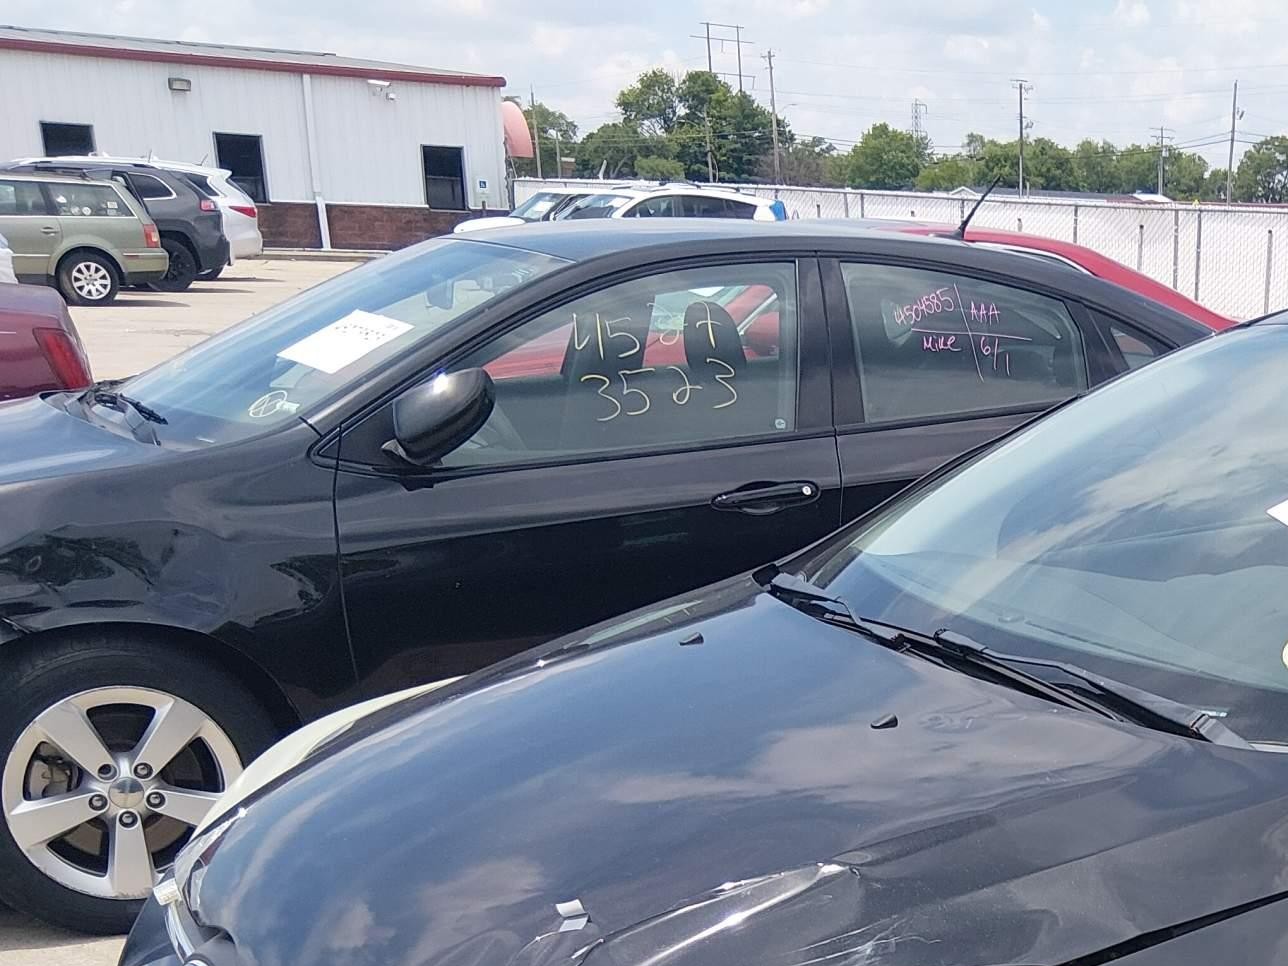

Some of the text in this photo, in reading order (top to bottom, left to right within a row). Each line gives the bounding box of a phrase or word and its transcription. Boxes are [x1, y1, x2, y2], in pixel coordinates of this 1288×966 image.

[894, 286, 955, 326] 4504585
[970, 301, 1001, 327] AAA
[980, 335, 1011, 376] 6/1
[580, 357, 738, 422] 3523
